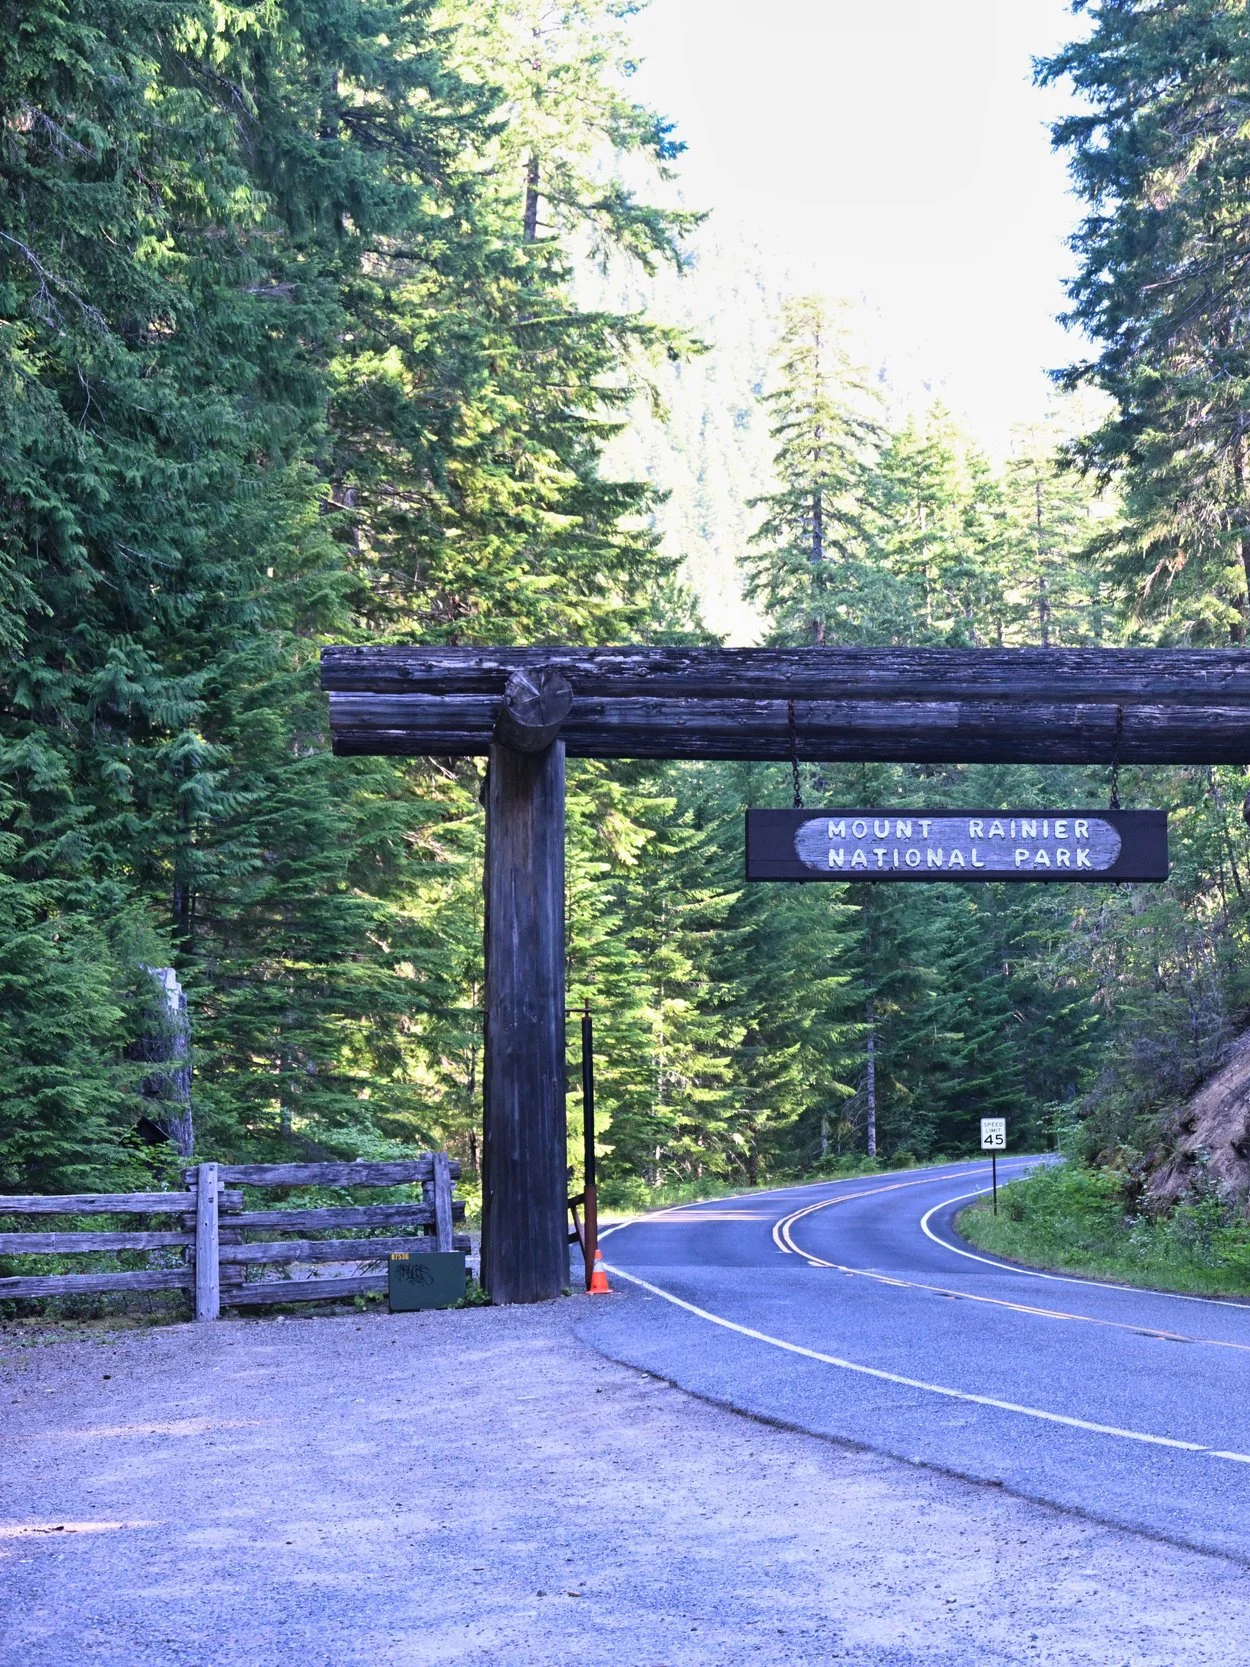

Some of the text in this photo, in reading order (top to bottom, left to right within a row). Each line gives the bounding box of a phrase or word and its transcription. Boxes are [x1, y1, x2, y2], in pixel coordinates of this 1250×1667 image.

[827, 820, 1090, 839] MOUNT RAINIER
[827, 848, 1092, 868] NATIONAL PARK
[984, 1134, 1004, 1145] 45
